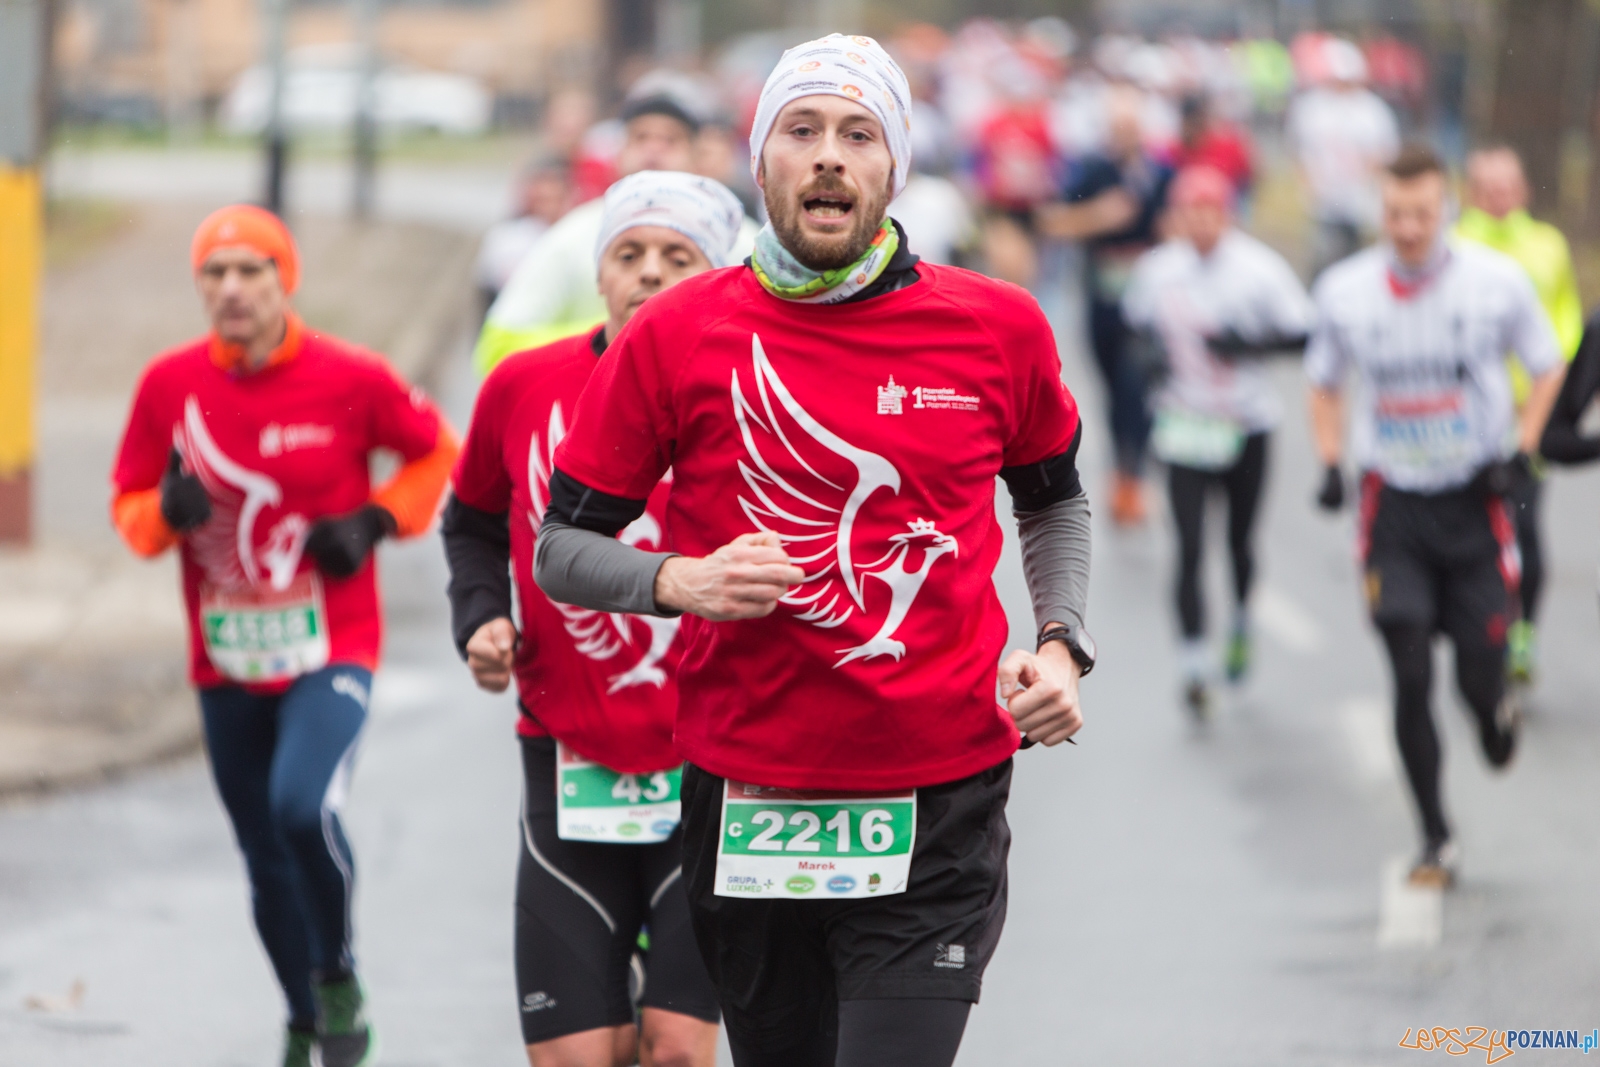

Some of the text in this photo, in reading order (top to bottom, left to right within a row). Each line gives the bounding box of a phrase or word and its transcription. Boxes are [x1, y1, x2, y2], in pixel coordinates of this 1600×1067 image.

[912, 386, 925, 409] 1
[611, 771, 671, 804] 43
[746, 808, 895, 853] 2216
[797, 860, 836, 871] Marek
[725, 884, 763, 893] LUXMED
[727, 875, 758, 885] GRUPA
